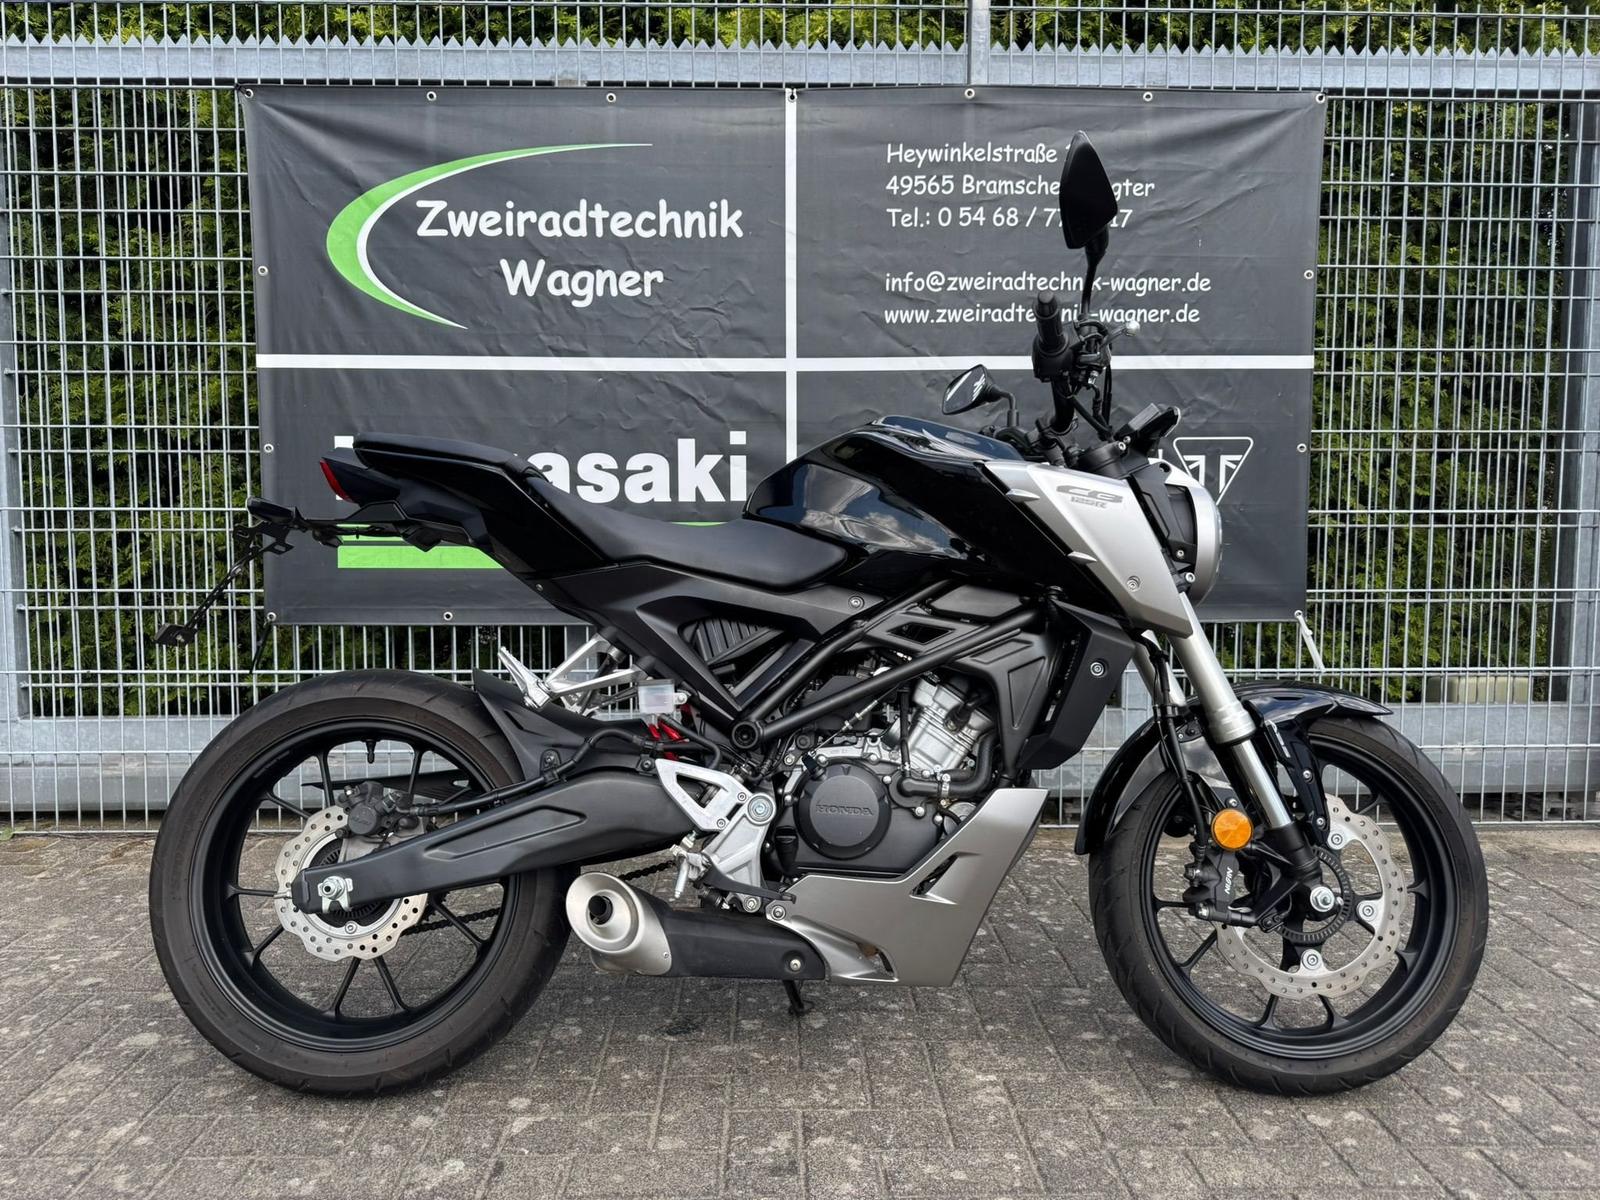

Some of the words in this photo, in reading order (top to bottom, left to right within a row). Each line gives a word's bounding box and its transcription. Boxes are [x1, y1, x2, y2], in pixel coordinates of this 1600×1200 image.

[886, 142, 1058, 168] Heywinkelstraße
[886, 175, 954, 195] 49565
[416, 198, 744, 239] Zweiradtechnik
[886, 207, 930, 227] Tel.:
[938, 207, 951, 226] 0
[959, 206, 986, 226] 54
[992, 207, 1019, 227] 68
[1025, 206, 1037, 228] /
[500, 259, 664, 308] Wagner
[885, 270, 1212, 297] info@zweiradtechnk-wagner.de
[884, 302, 1201, 324] www.zweiradteni-wagner.de
[815, 804, 875, 817] HONDA
